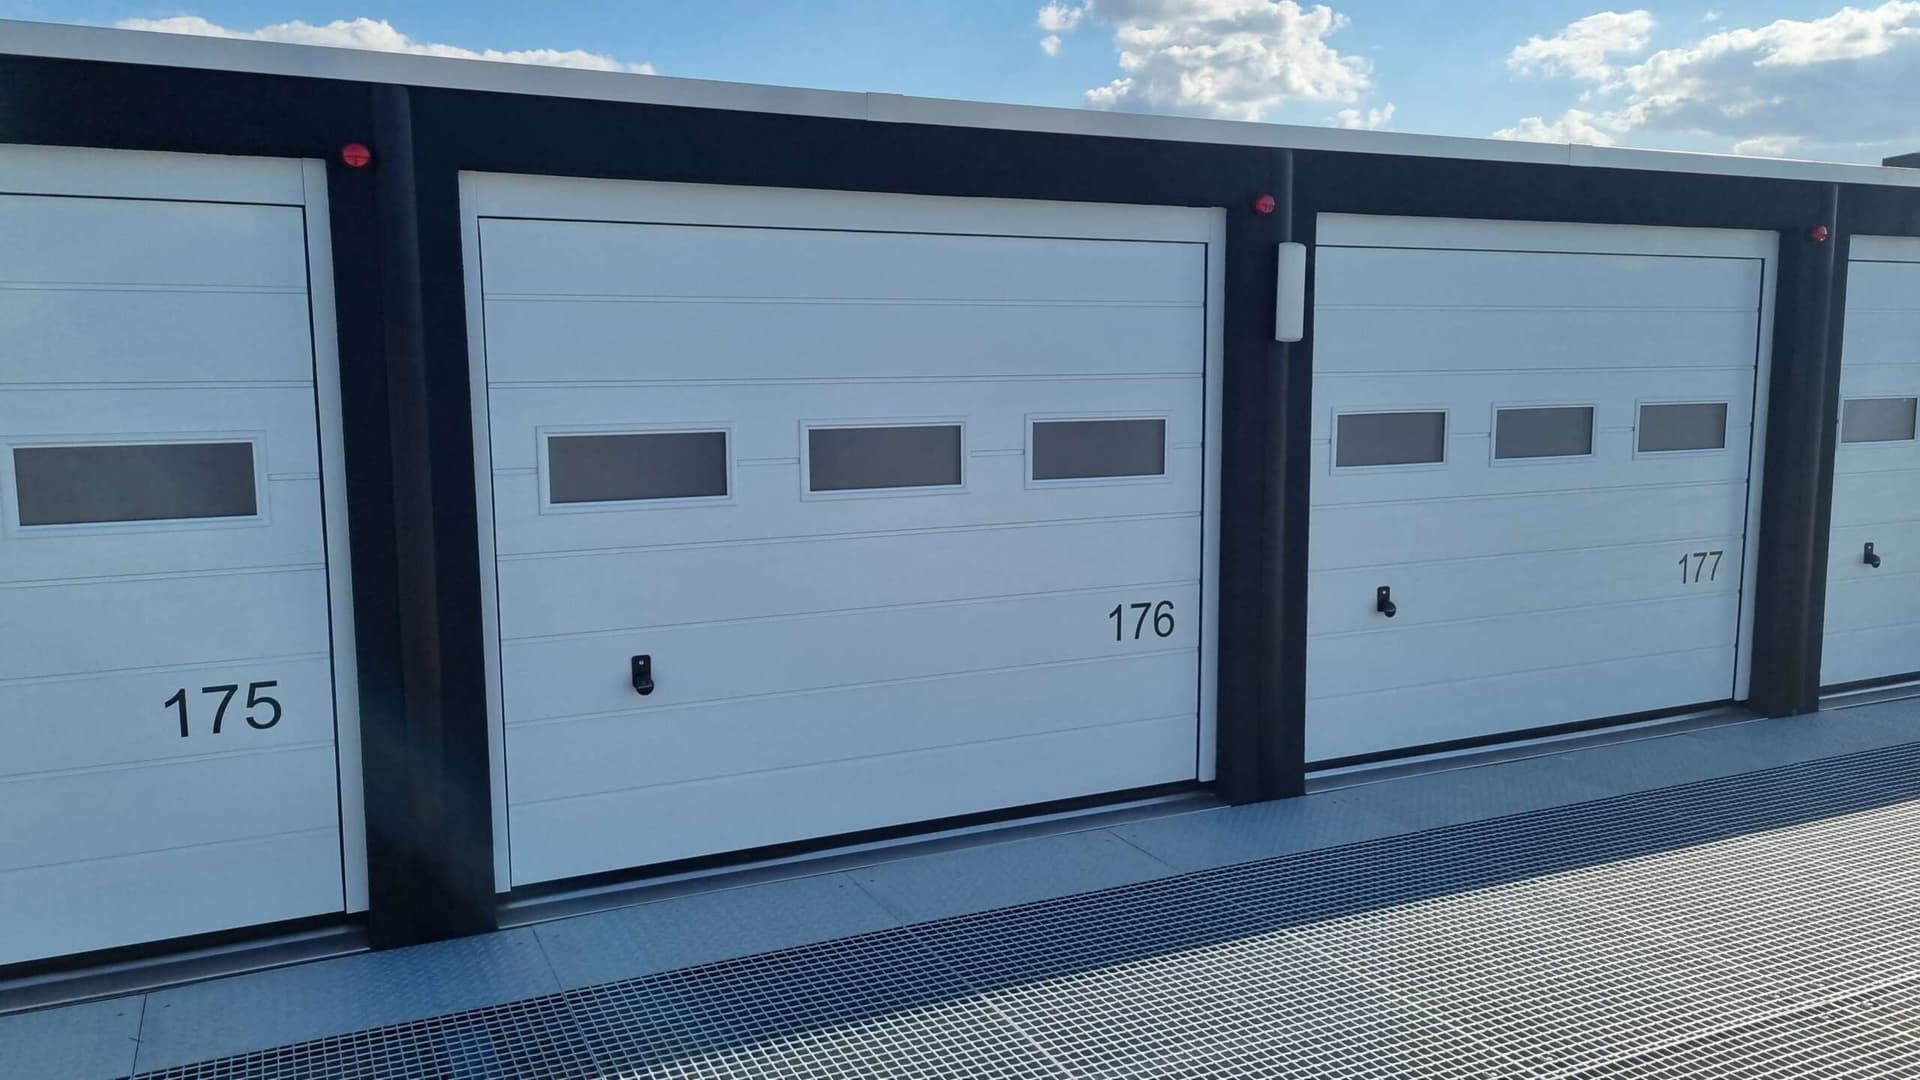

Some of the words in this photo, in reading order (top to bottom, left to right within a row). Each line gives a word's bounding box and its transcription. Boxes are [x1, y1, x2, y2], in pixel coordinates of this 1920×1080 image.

[1678, 551, 1724, 584] 177
[1108, 600, 1175, 642] 176
[164, 680, 282, 738] 175
